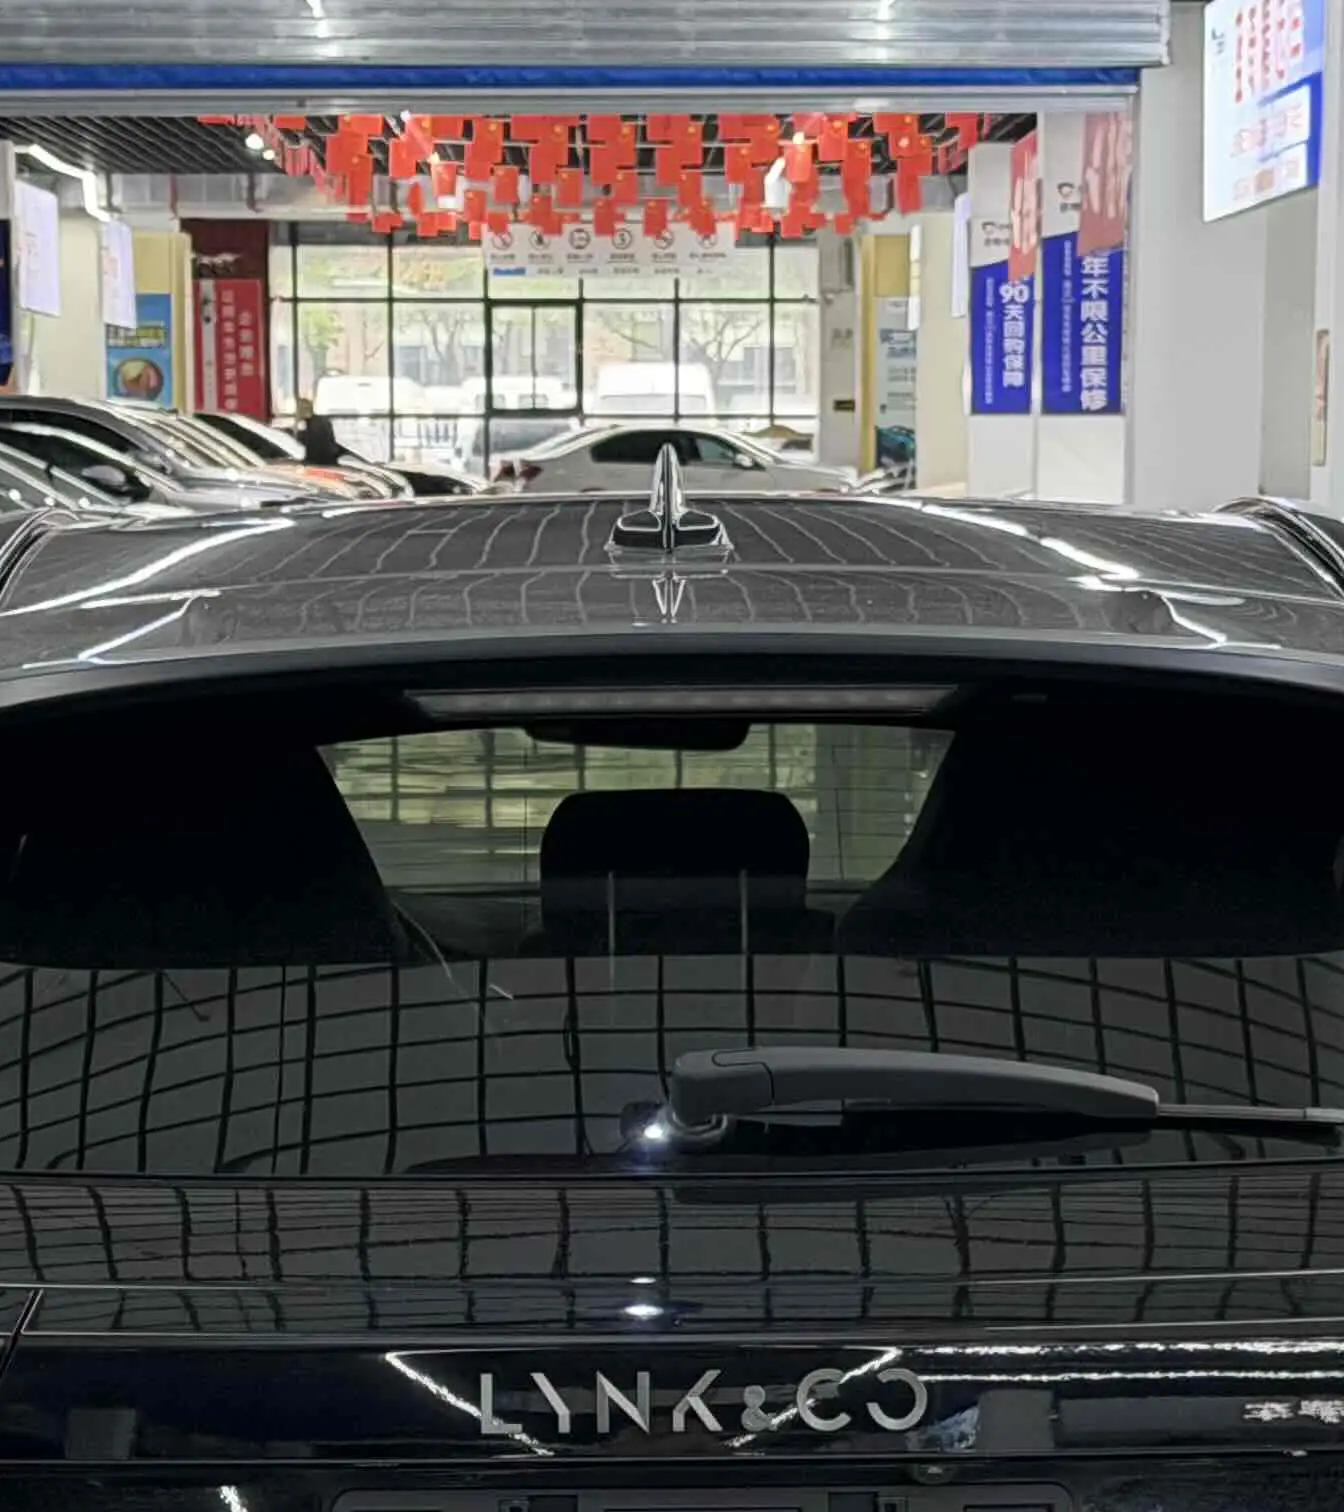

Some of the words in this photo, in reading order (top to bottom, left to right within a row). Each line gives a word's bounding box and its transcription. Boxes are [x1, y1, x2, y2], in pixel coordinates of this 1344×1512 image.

[998, 276, 1031, 388] 90天回购保障
[1080, 250, 1110, 411] 年不限公里保修
